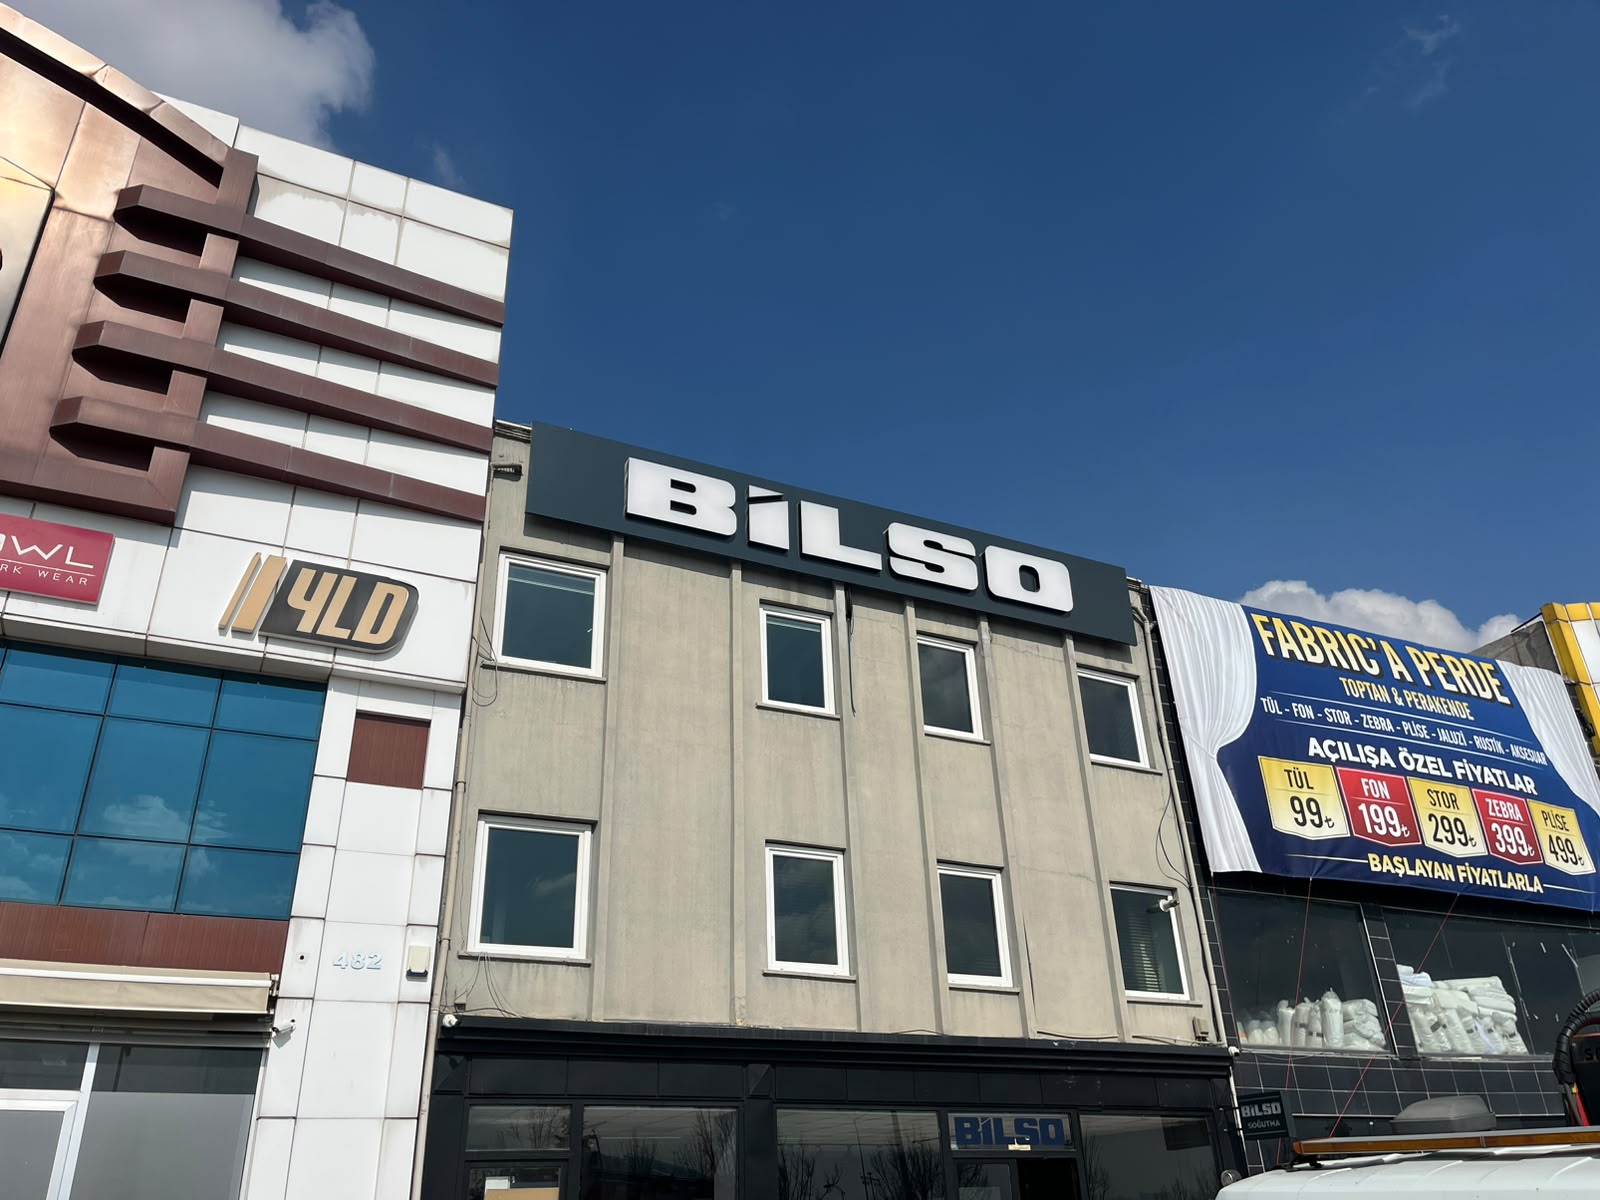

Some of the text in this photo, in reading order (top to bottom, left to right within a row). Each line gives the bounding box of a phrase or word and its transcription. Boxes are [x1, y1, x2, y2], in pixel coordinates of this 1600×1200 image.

[38, 570, 88, 585] WEAR
[287, 568, 409, 645] YLD
[1405, 646, 1511, 705] PERDE
[1339, 677, 1474, 720] TOPTAN & PERAKENDE
[1261, 697, 1282, 715] TÜL
[1292, 703, 1314, 720] FON
[1324, 708, 1352, 725] STOR
[1361, 714, 1394, 733] ZEBRA
[1402, 721, 1430, 739] PLİSE
[1437, 727, 1467, 746] JALUZİ
[1474, 735, 1504, 754] RUSTİK
[1510, 744, 1548, 766] AKSESUAR
[1308, 737, 1538, 795] AÇILIŞA ÖZEL FİYATLAR
[1284, 767, 1314, 790] TÜL
[1361, 778, 1391, 800] FON
[1427, 788, 1459, 810] STOR
[1485, 798, 1523, 822] ZEBRA
[1541, 809, 1570, 832] PLİSE
[1367, 853, 1544, 893] BAŞLAYAN FİYATLARLA
[333, 951, 382, 970] 482
